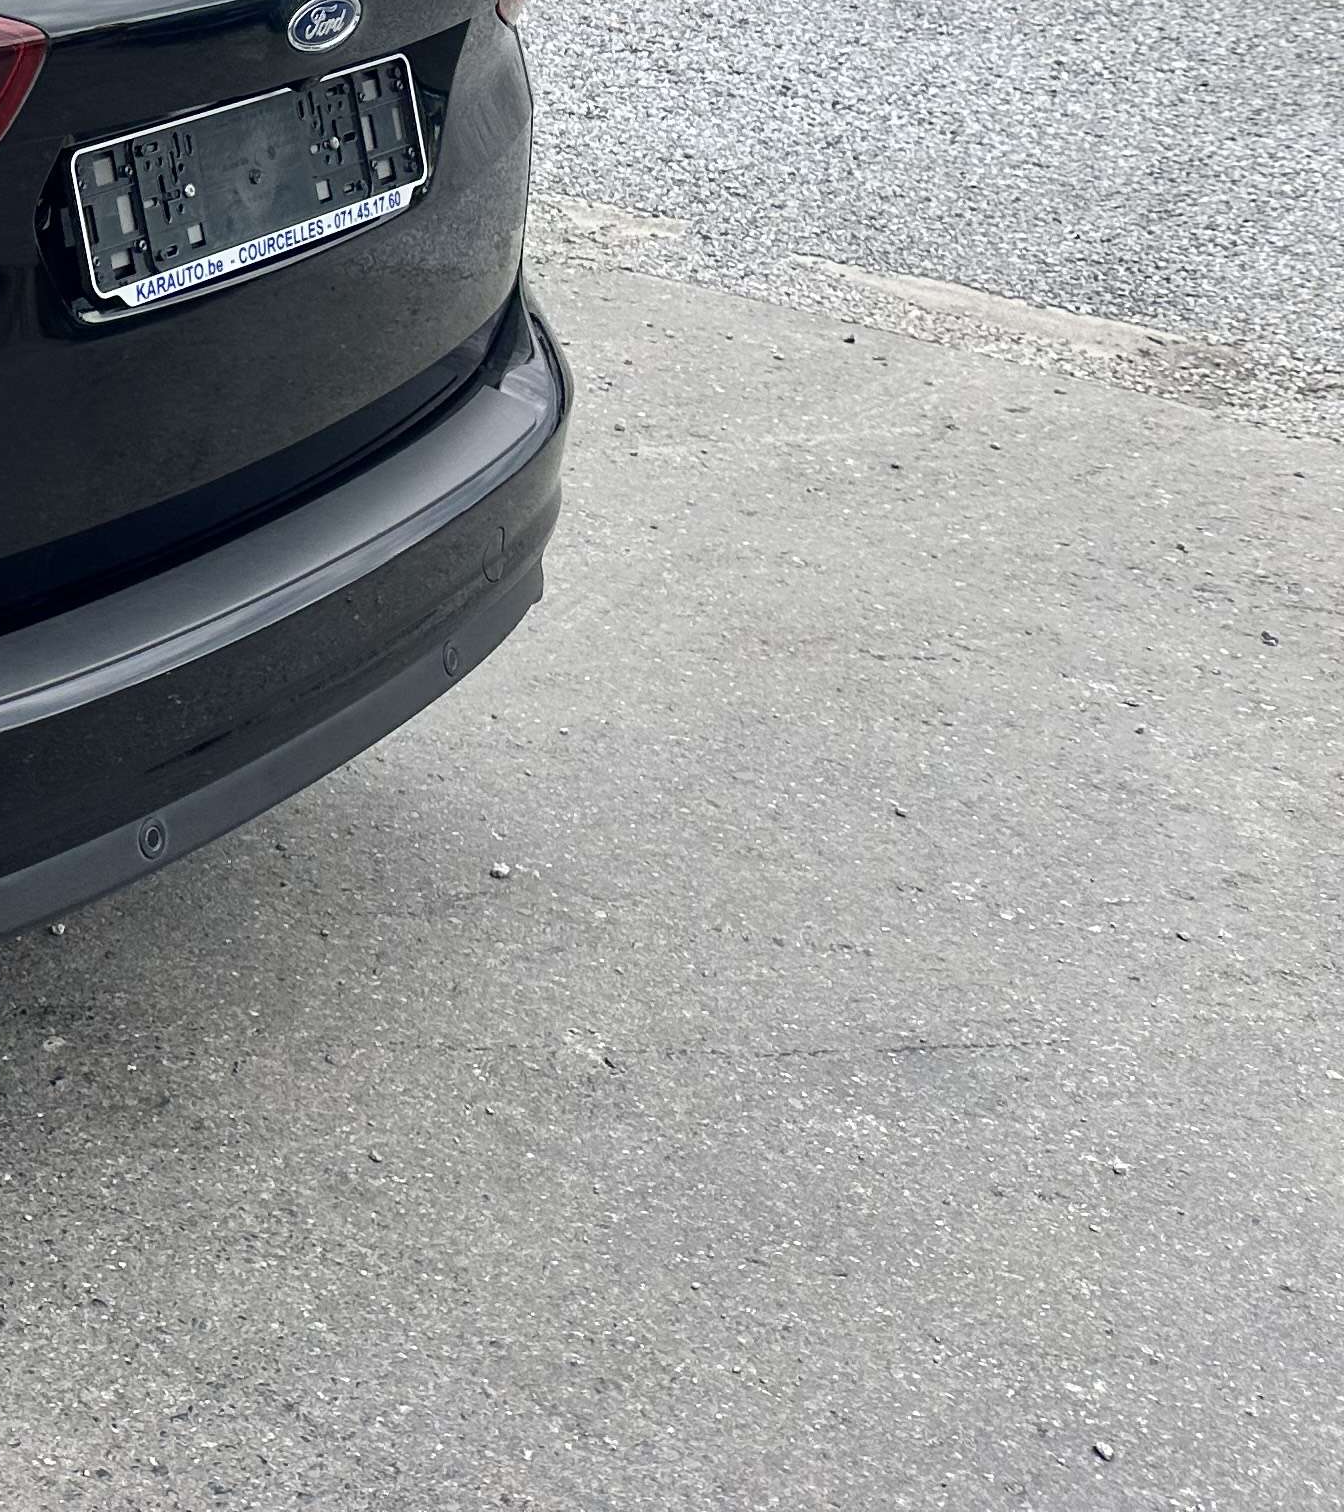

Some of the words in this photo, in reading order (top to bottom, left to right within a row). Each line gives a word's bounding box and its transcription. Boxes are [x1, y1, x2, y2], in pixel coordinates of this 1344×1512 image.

[305, 3, 347, 40] Ford
[135, 258, 224, 303] KARAUTO.be
[238, 219, 324, 264] COURCELLES
